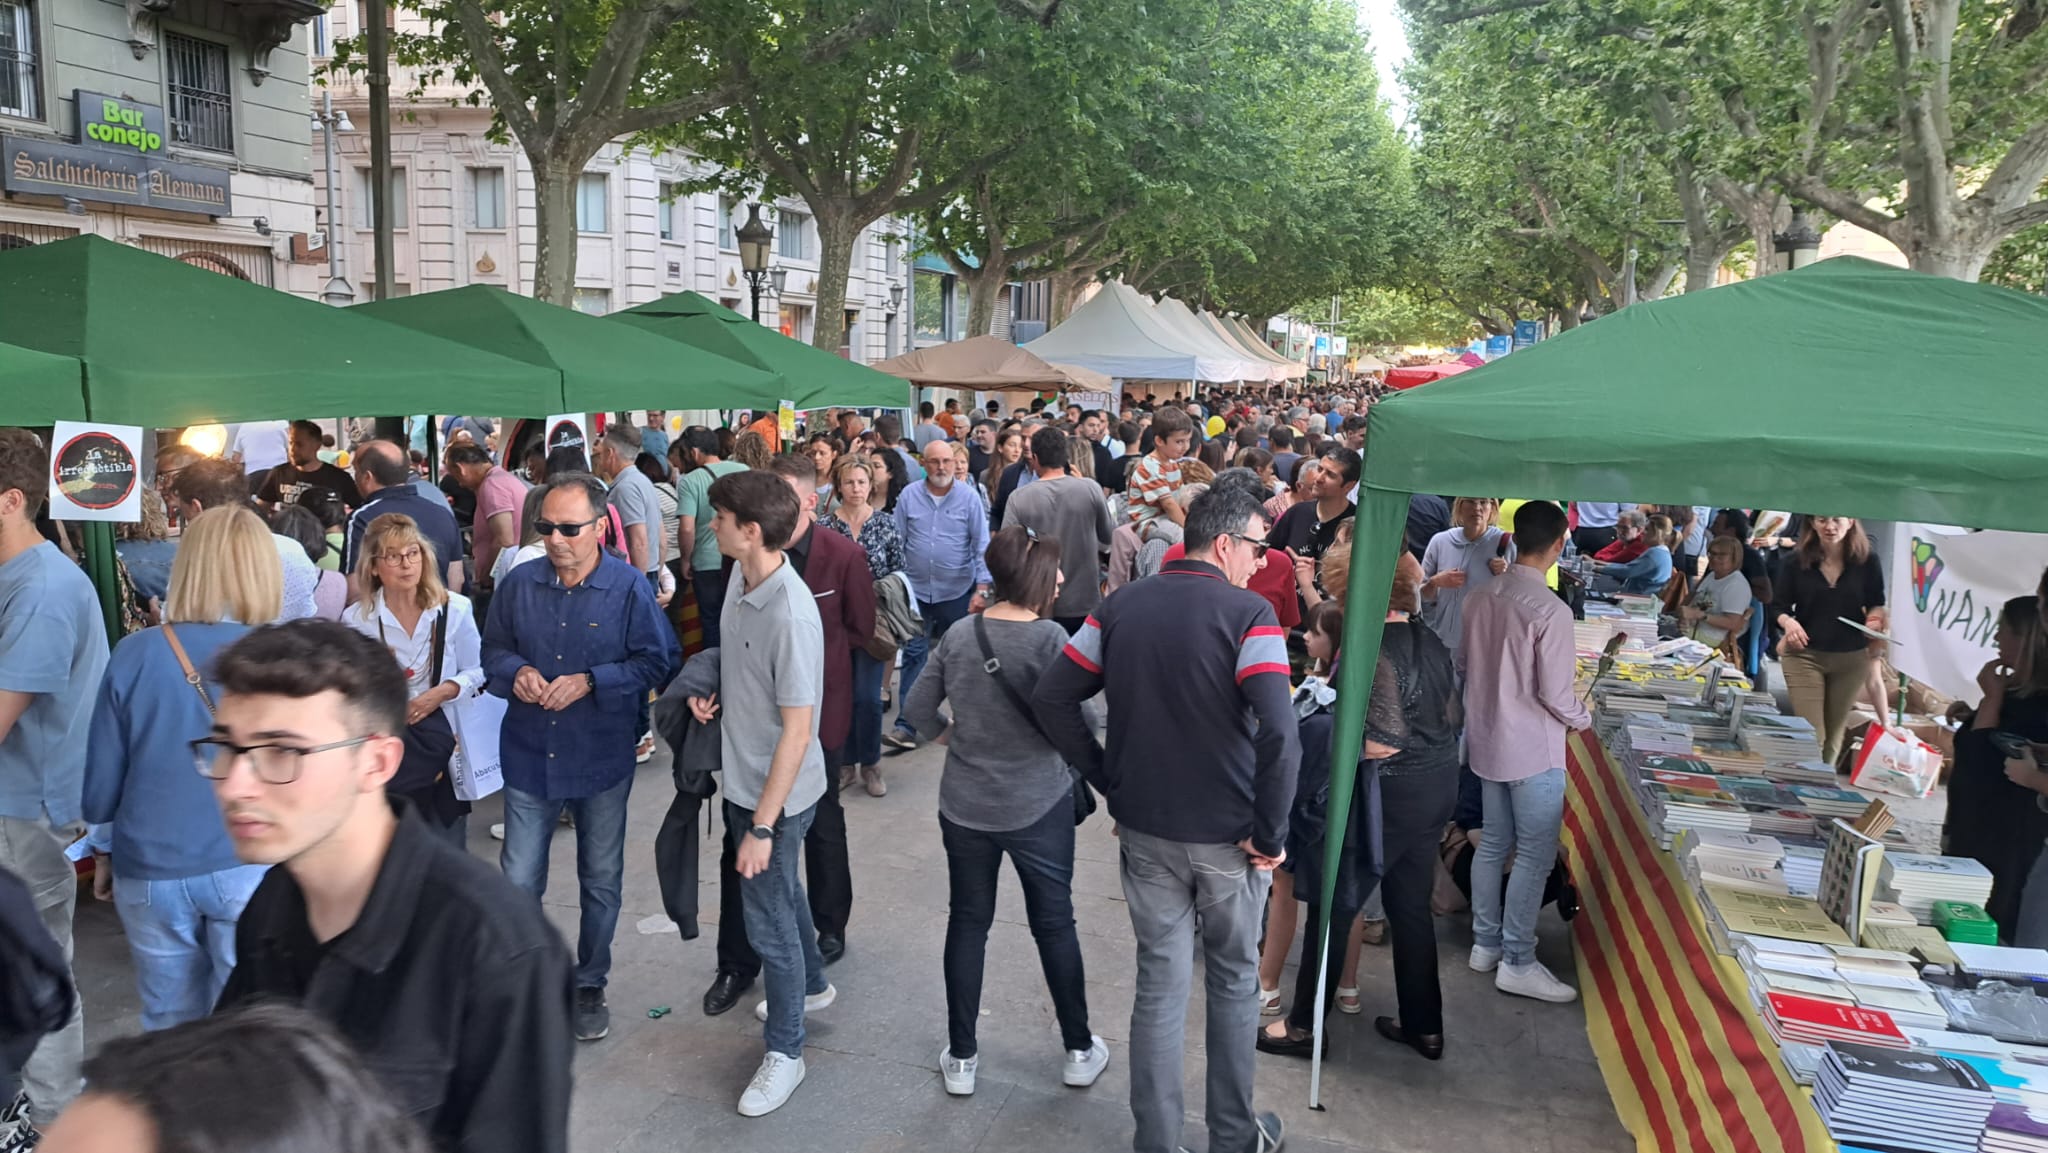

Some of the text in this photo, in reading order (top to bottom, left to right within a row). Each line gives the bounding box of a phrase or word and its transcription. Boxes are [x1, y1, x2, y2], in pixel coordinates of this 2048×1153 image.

[103, 99, 143, 127] Bar
[87, 122, 161, 152] conejo
[150, 169, 225, 202] Alemana
[1932, 588, 2000, 648] NAN
[474, 762, 501, 778] Abacus
